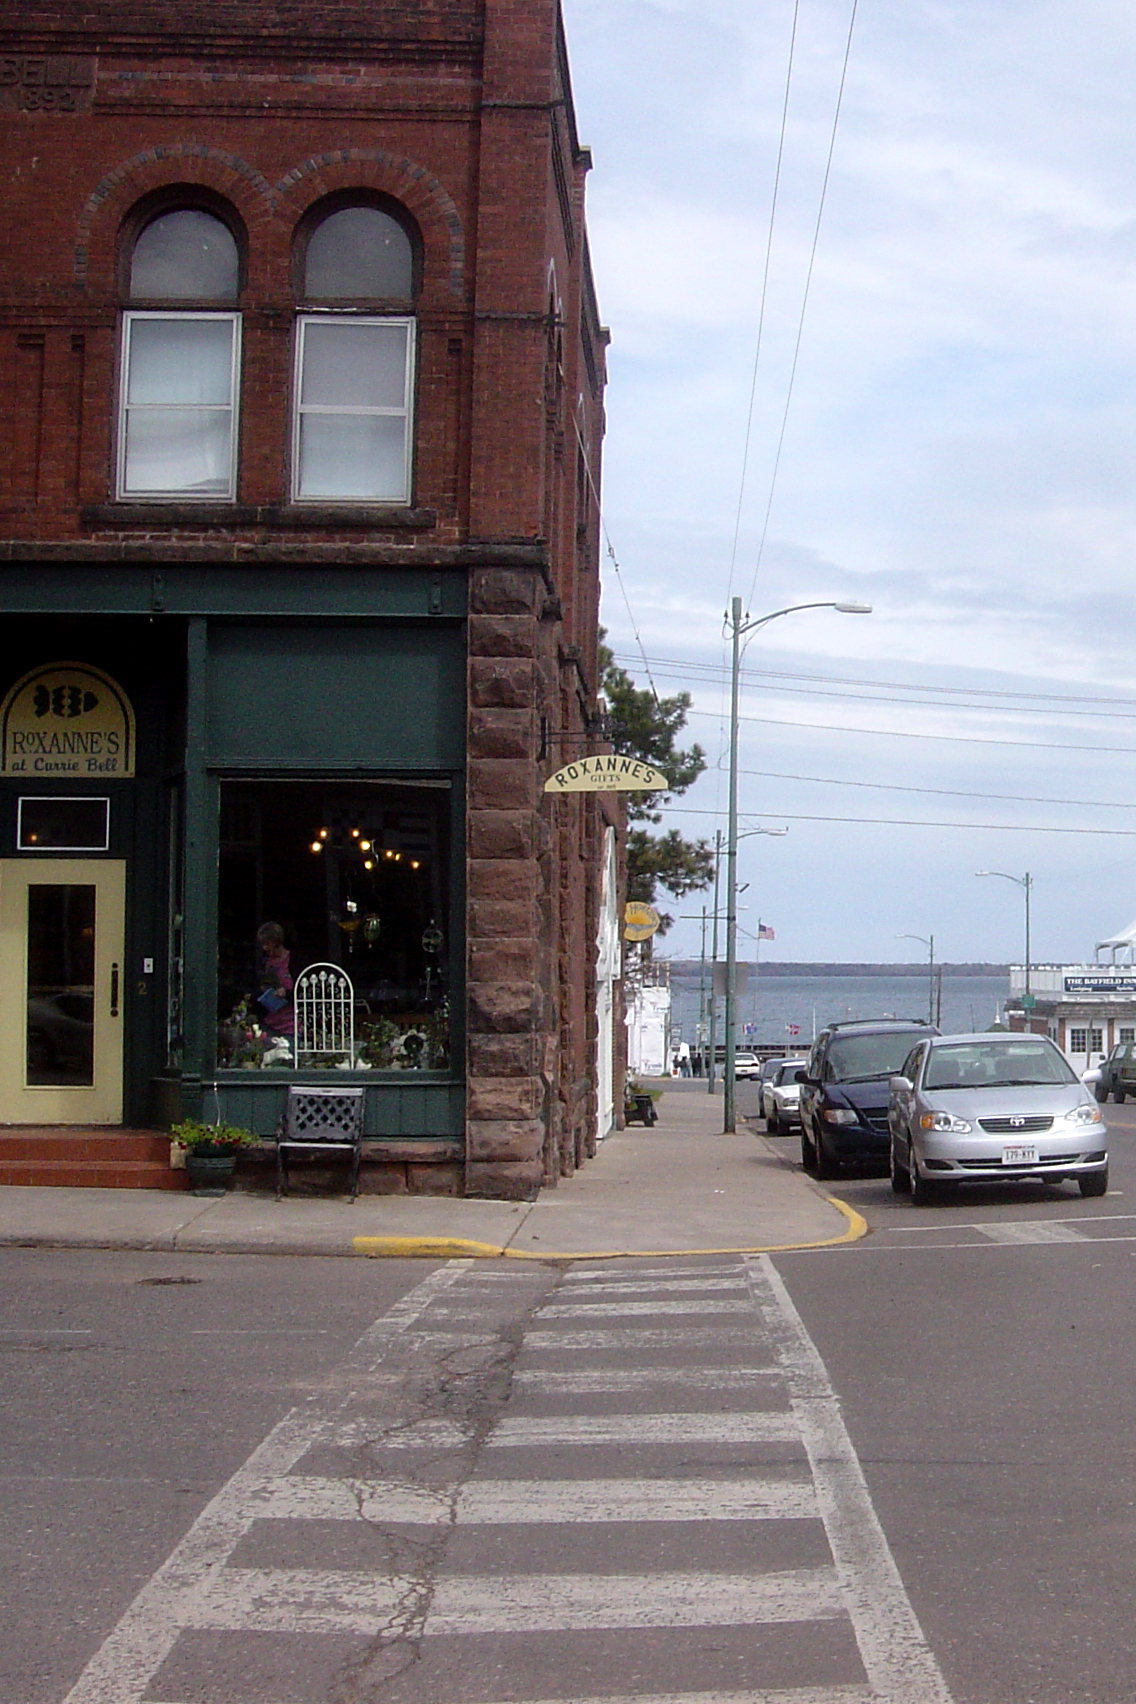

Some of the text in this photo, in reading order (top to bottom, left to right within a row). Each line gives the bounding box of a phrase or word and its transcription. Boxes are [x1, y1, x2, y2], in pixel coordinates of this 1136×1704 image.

[12, 731, 119, 755] ROXANNE'S
[12, 757, 117, 772] at Currie Bell
[555, 757, 655, 787] ROXANNE'S
[590, 774, 621, 783] GIFTS
